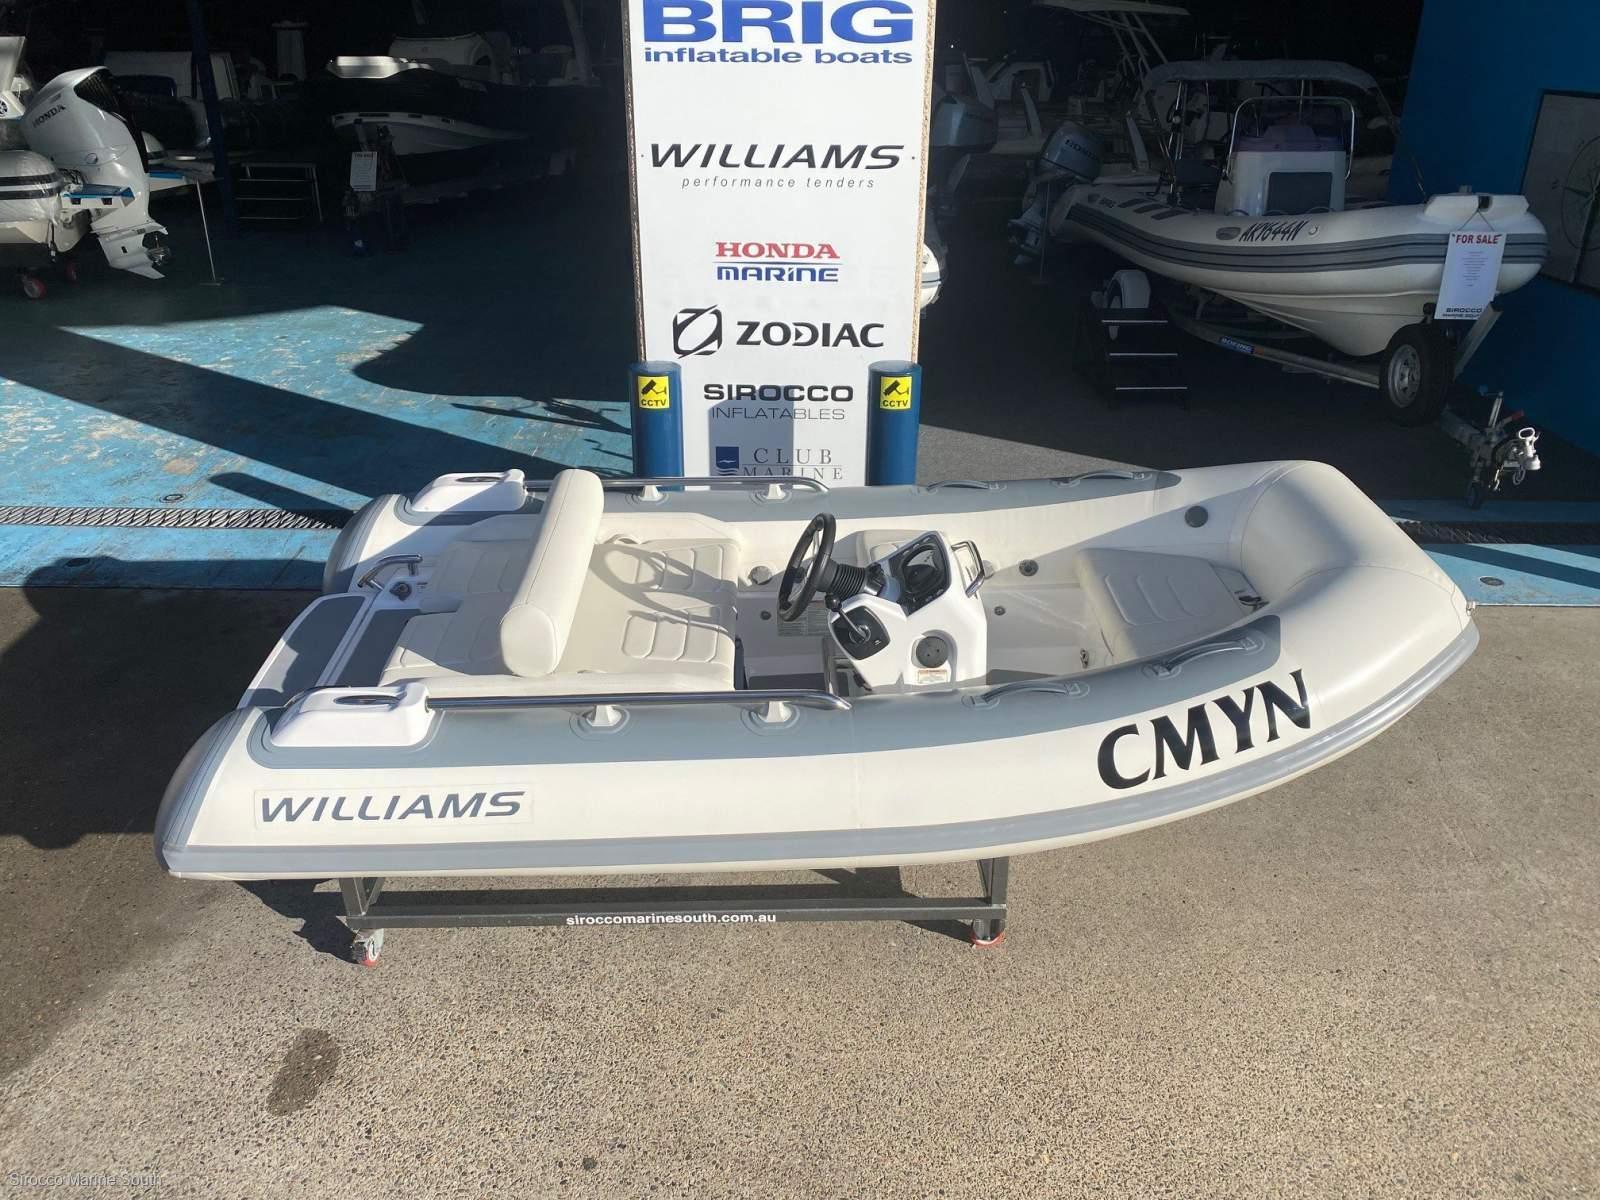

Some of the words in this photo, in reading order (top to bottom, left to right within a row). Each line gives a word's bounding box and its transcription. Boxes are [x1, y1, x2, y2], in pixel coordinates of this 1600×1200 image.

[643, 0, 914, 44] BRIG
[645, 47, 803, 63] inflatable
[815, 49, 912, 64] boats
[650, 143, 904, 169] WILLIAMS
[682, 176, 796, 189] performance
[806, 177, 874, 188] tenders
[1455, 234, 1473, 244] FOR
[1475, 234, 1499, 244] SALE
[715, 242, 840, 259] HONDA
[736, 320, 884, 348] ZODIAC
[703, 383, 854, 402] SIROCCO
[641, 398, 667, 407] CCTV
[882, 399, 909, 408] CCTV
[712, 407, 845, 420] INFLATABLES
[753, 447, 832, 465] CLUB
[743, 467, 843, 480] MARINE
[1097, 669, 1312, 790] CMYN
[261, 790, 526, 823] WILLIAMS
[566, 912, 777, 925] siroccomarinesouth.com.au
